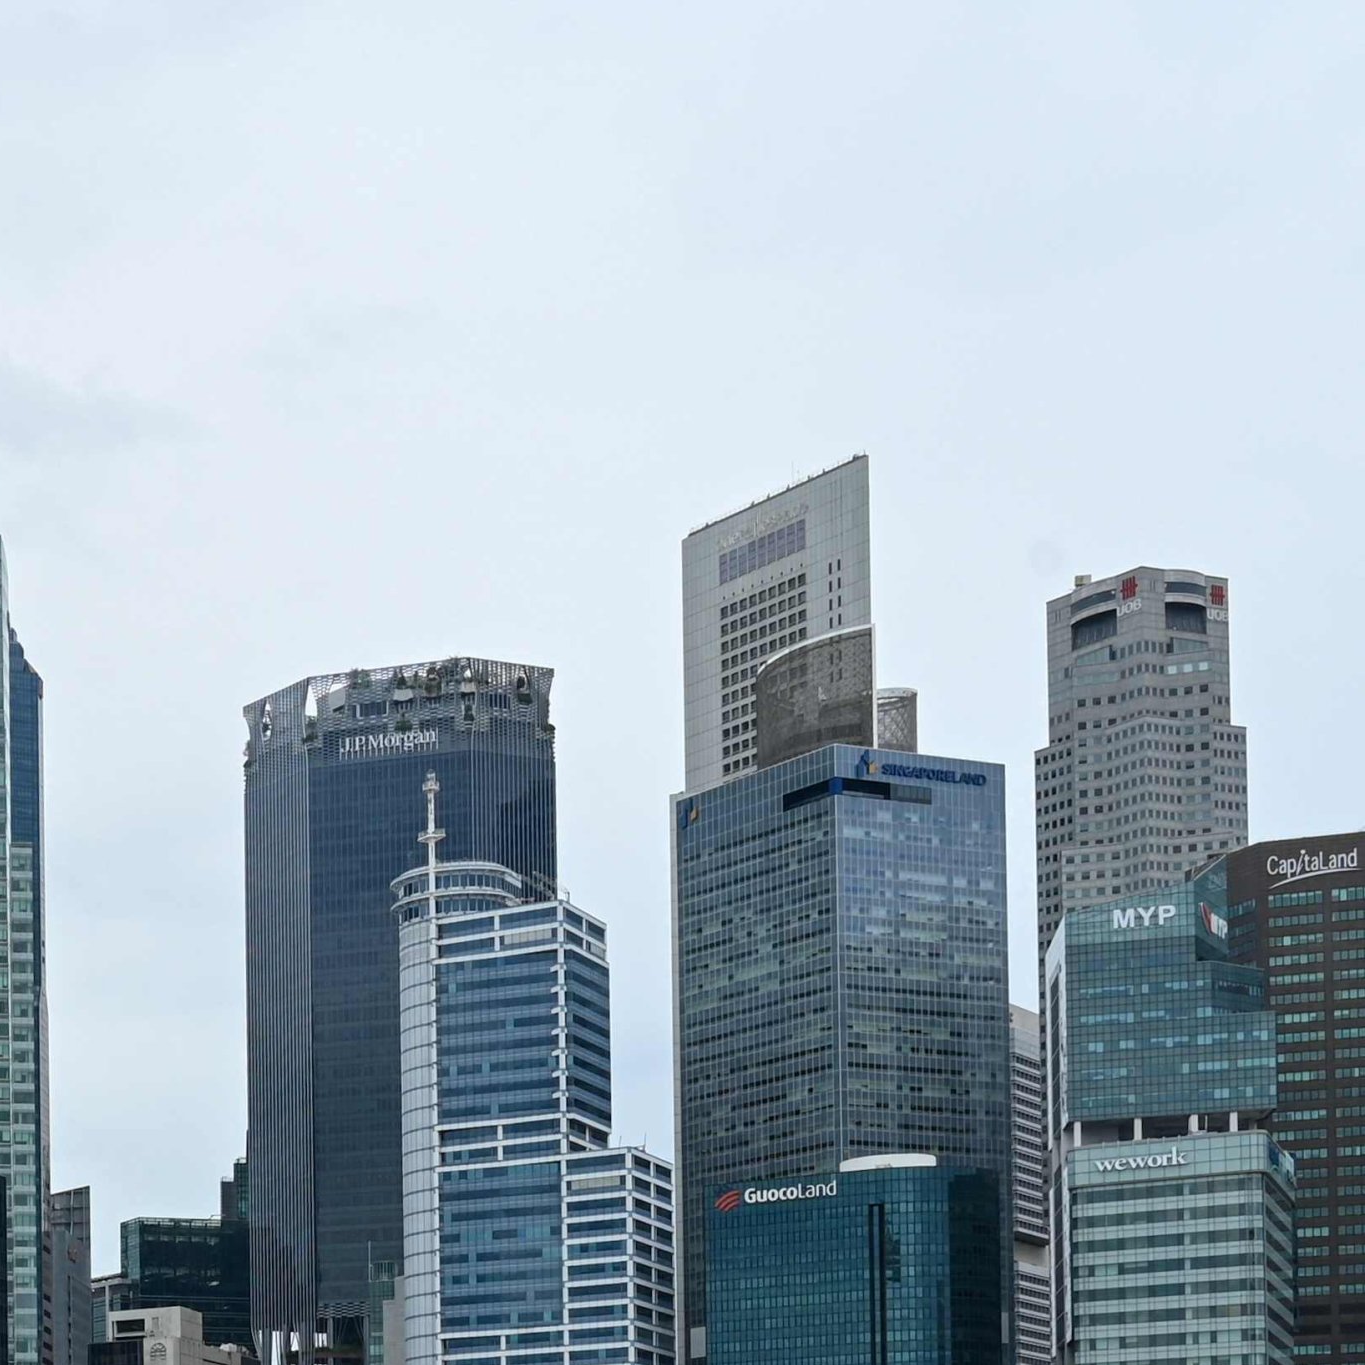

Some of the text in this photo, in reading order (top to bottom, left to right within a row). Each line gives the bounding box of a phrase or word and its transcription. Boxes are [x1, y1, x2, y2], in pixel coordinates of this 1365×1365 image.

[1116, 597, 1142, 617] UOB
[1207, 608, 1228, 622] UOB
[1266, 847, 1358, 879] CapitaLand
[1112, 905, 1177, 929] MYP
[1094, 1146, 1188, 1173] wework
[744, 1180, 837, 1205] GuocoLand
